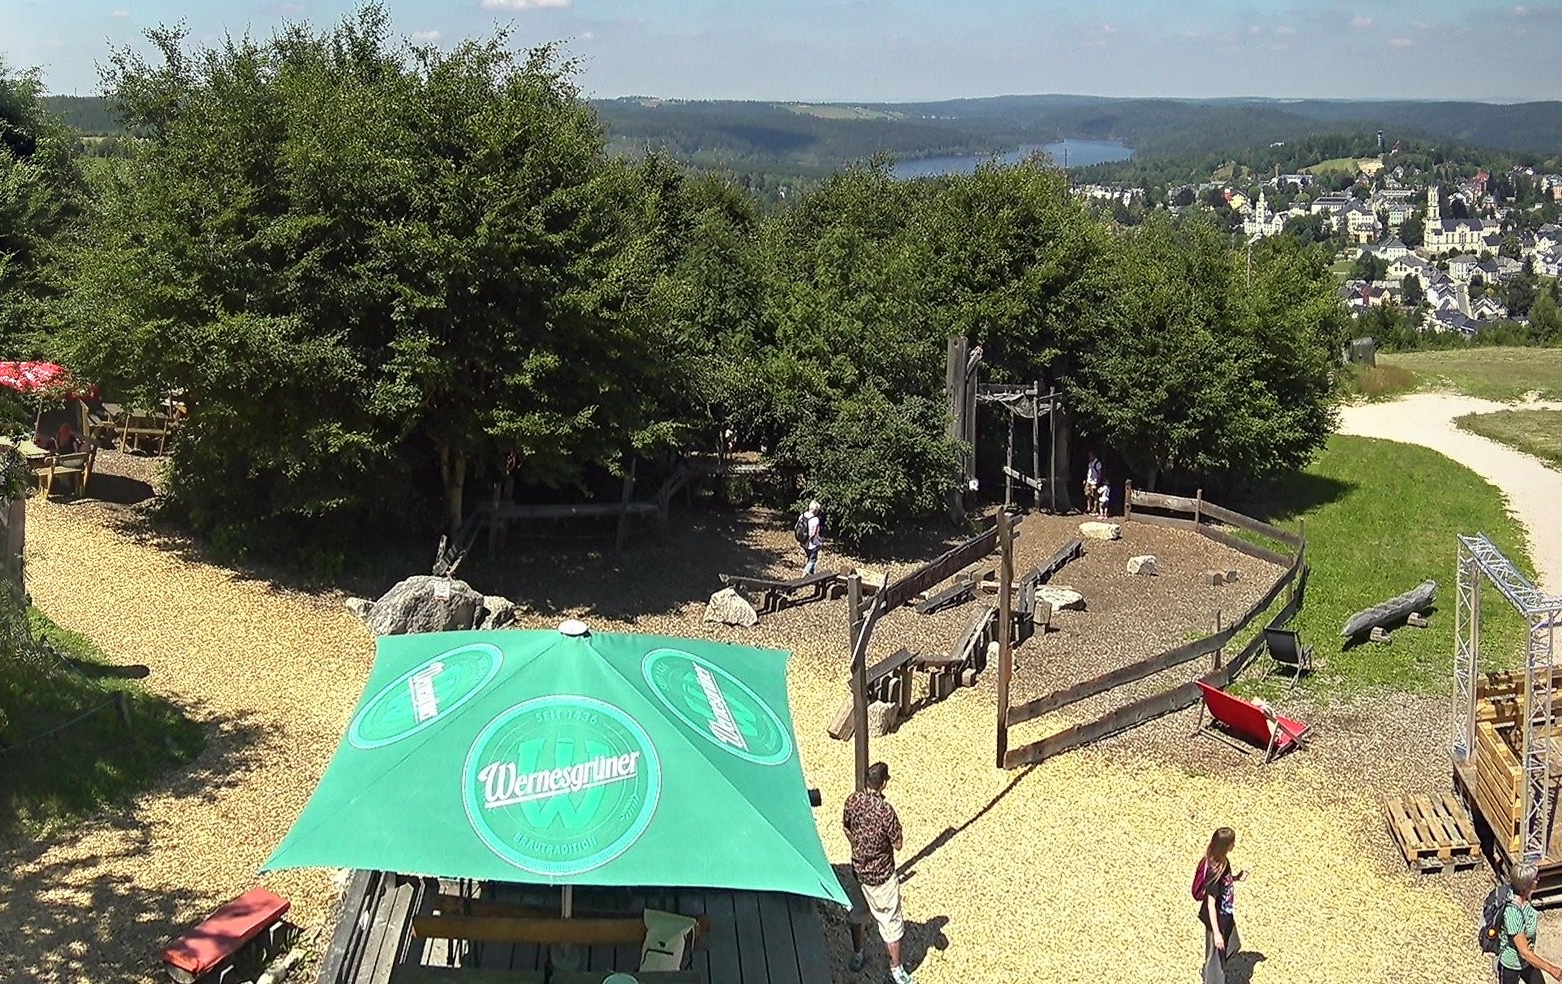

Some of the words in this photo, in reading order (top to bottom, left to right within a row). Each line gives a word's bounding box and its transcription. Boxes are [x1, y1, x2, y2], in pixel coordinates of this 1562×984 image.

[535, 710, 562, 724] SEIT
[478, 750, 640, 803] Wernesgrüner
[512, 831, 599, 855] BRAUTRADITION
